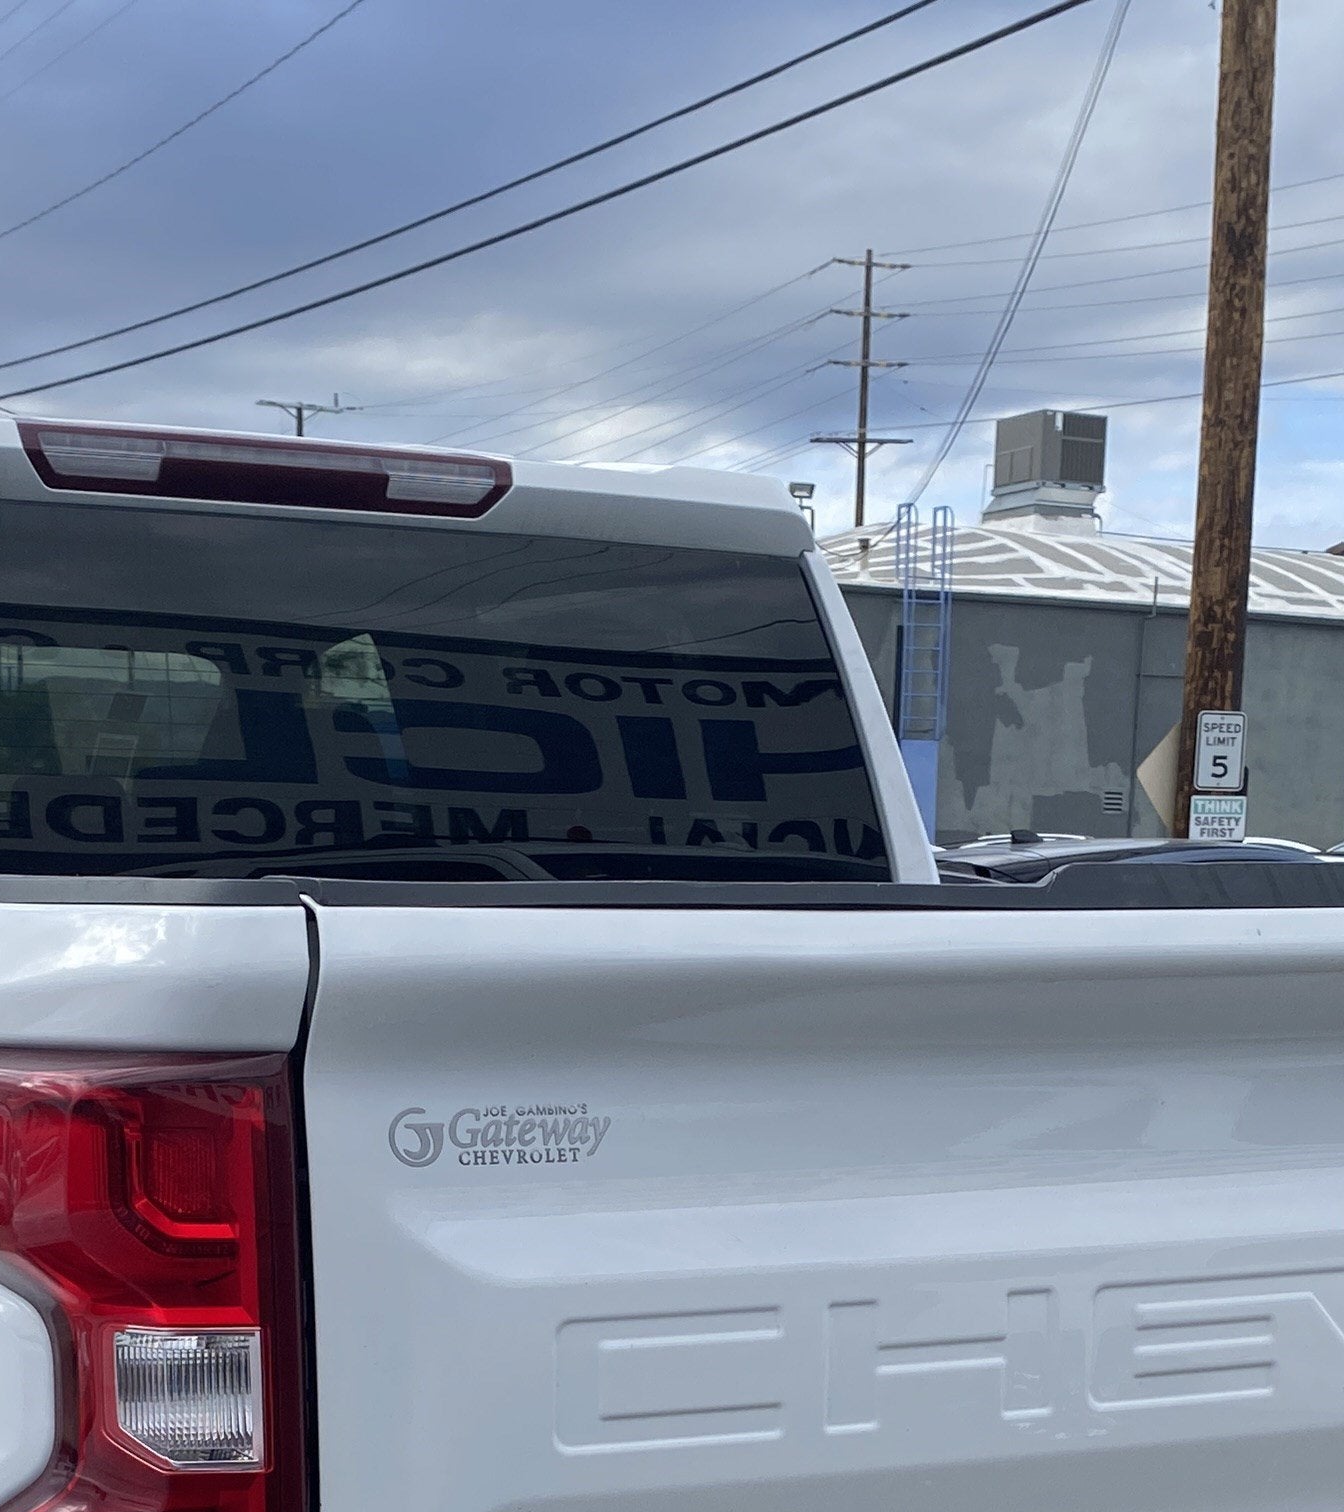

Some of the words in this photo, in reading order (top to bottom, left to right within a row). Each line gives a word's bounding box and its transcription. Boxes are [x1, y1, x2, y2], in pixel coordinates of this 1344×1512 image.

[1203, 723, 1242, 734] SPEED
[1206, 736, 1237, 746] LIMIT
[1211, 755, 1228, 779] 5
[1195, 799, 1243, 813] THINK
[1194, 816, 1242, 827] SAFETY
[1200, 828, 1235, 838] FIRST
[483, 1105, 506, 1118] JOE
[449, 1107, 611, 1157] Gateway
[458, 1147, 581, 1166] CHEVROLET
